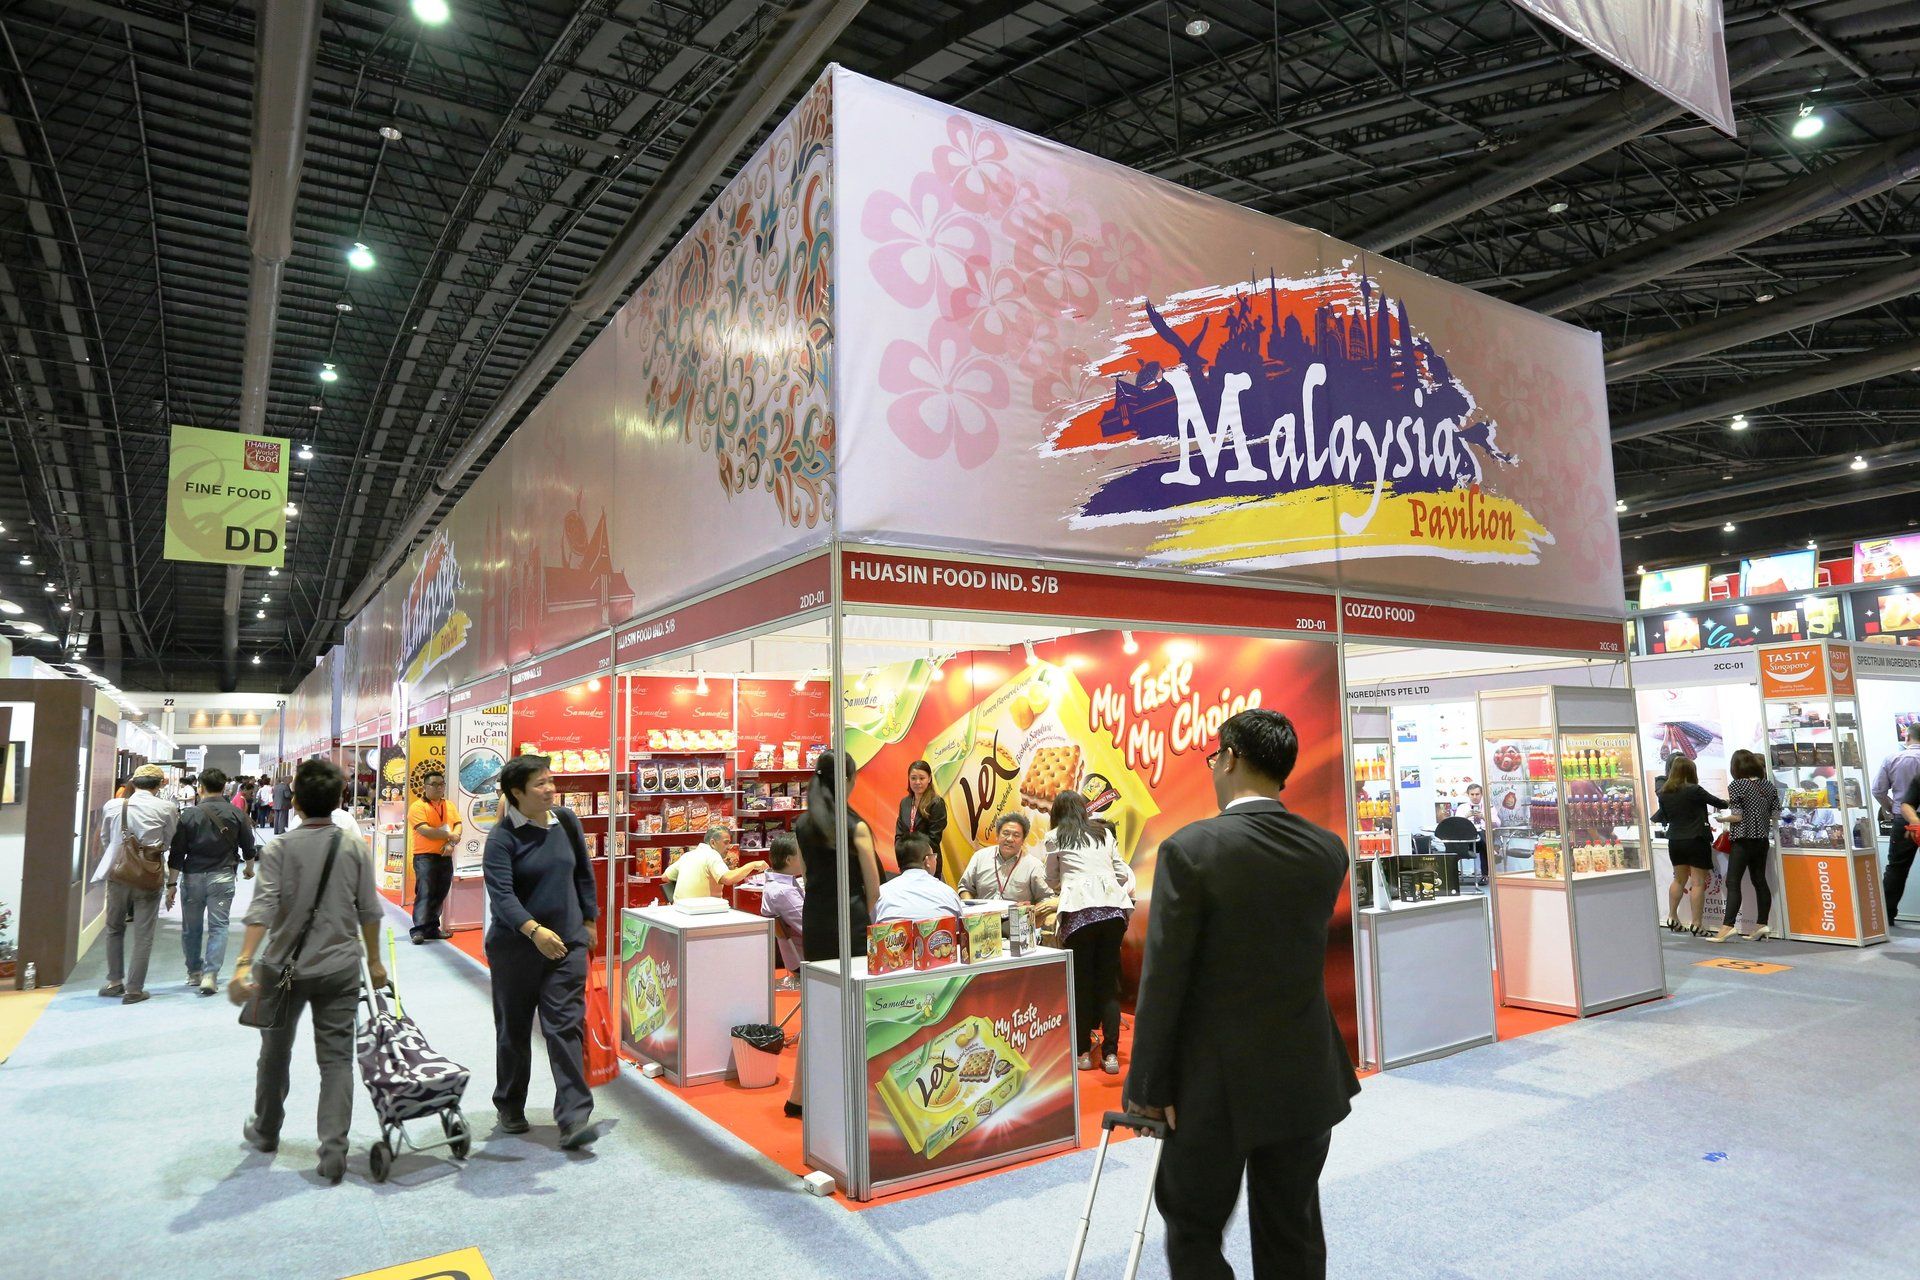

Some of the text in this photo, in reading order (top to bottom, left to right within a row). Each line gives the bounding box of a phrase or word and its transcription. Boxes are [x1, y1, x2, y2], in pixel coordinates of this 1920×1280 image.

[1160, 362, 1463, 535] Malaysia
[185, 482, 271, 500] FINE FOOD
[1408, 484, 1516, 541] Pavilion
[225, 526, 278, 553] DD
[850, 560, 1059, 594] HUASIN FOOD IND. S/B
[799, 590, 825, 608] 2DD-01
[1345, 602, 1415, 623] COZZO FOOD
[1296, 618, 1326, 631] 2DD-01
[1767, 651, 1811, 663] TASTY
[1857, 655, 1886, 666] SPECTRUM
[1886, 657, 1917, 668] INGREDIENTS
[1714, 662, 1744, 670] 2CC-01
[1769, 663, 1809, 673] Singapore
[1346, 686, 1430, 699] INGREDIENTS PTE LTD
[164, 698, 174, 706] 22
[1091, 661, 1194, 748] My Taste
[563, 705, 605, 718] Samudra
[631, 706, 668, 718] Samudra
[692, 707, 730, 719] Samudra
[752, 706, 786, 719] Samudra
[466, 735, 488, 745] Jelly
[1128, 719, 1164, 786] My
[1817, 861, 1836, 932] Singapore
[873, 995, 916, 1011] Samudra
[994, 1003, 1037, 1041] My Taste
[1011, 1014, 1062, 1052] My Choice
